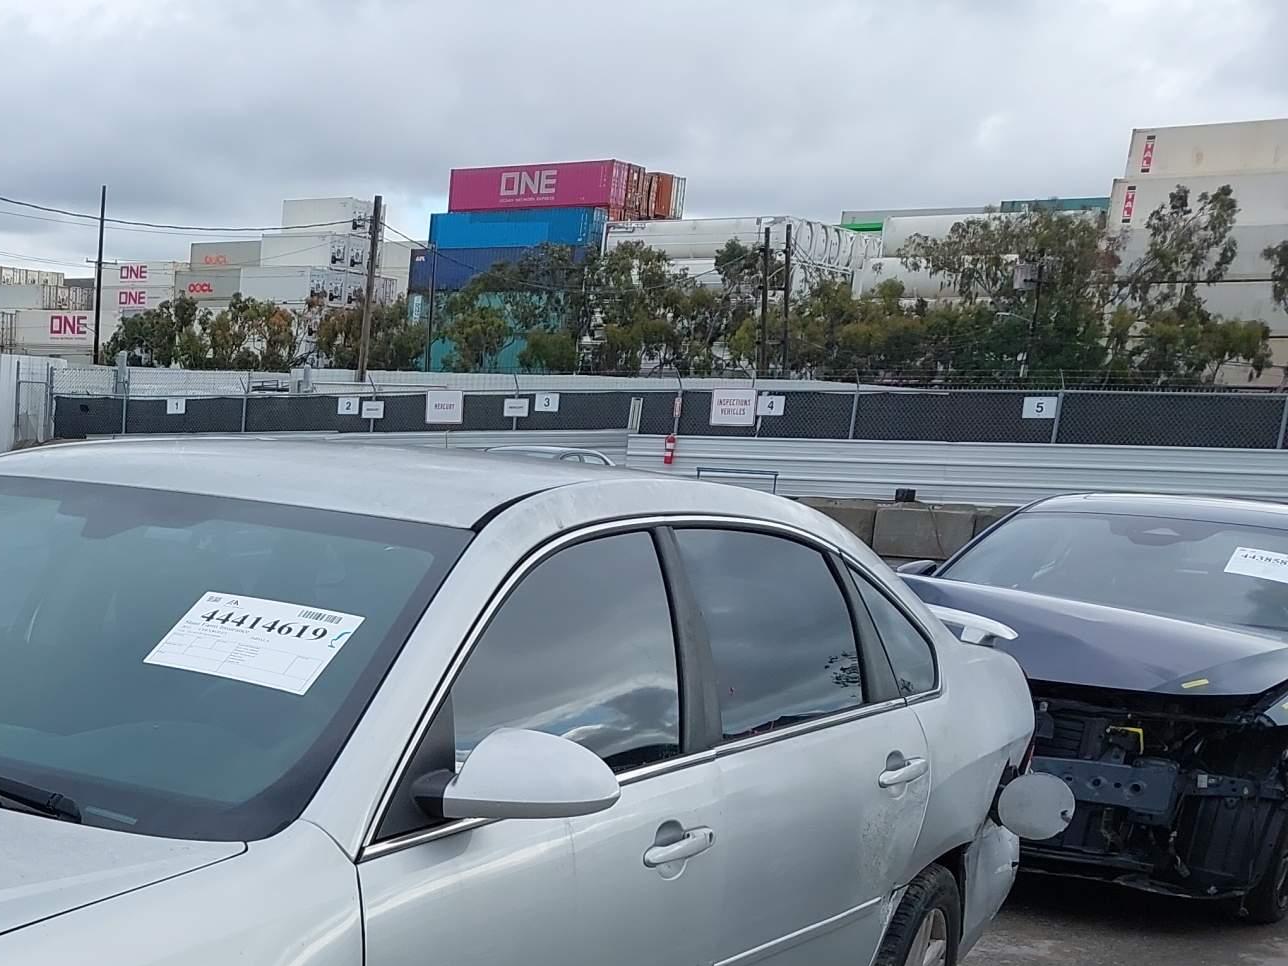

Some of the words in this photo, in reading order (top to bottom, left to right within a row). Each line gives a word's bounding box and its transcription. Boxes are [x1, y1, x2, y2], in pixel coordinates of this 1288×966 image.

[500, 170, 558, 196] ONE
[120, 265, 148, 279] ONE
[188, 283, 214, 293] OOCL
[118, 291, 146, 305] ONE
[50, 316, 88, 335] ONE
[345, 401, 352, 411] 2
[544, 397, 551, 407] 3
[767, 400, 775, 410] 4
[1035, 402, 1044, 413] 5
[201, 609, 328, 640] 44414619
